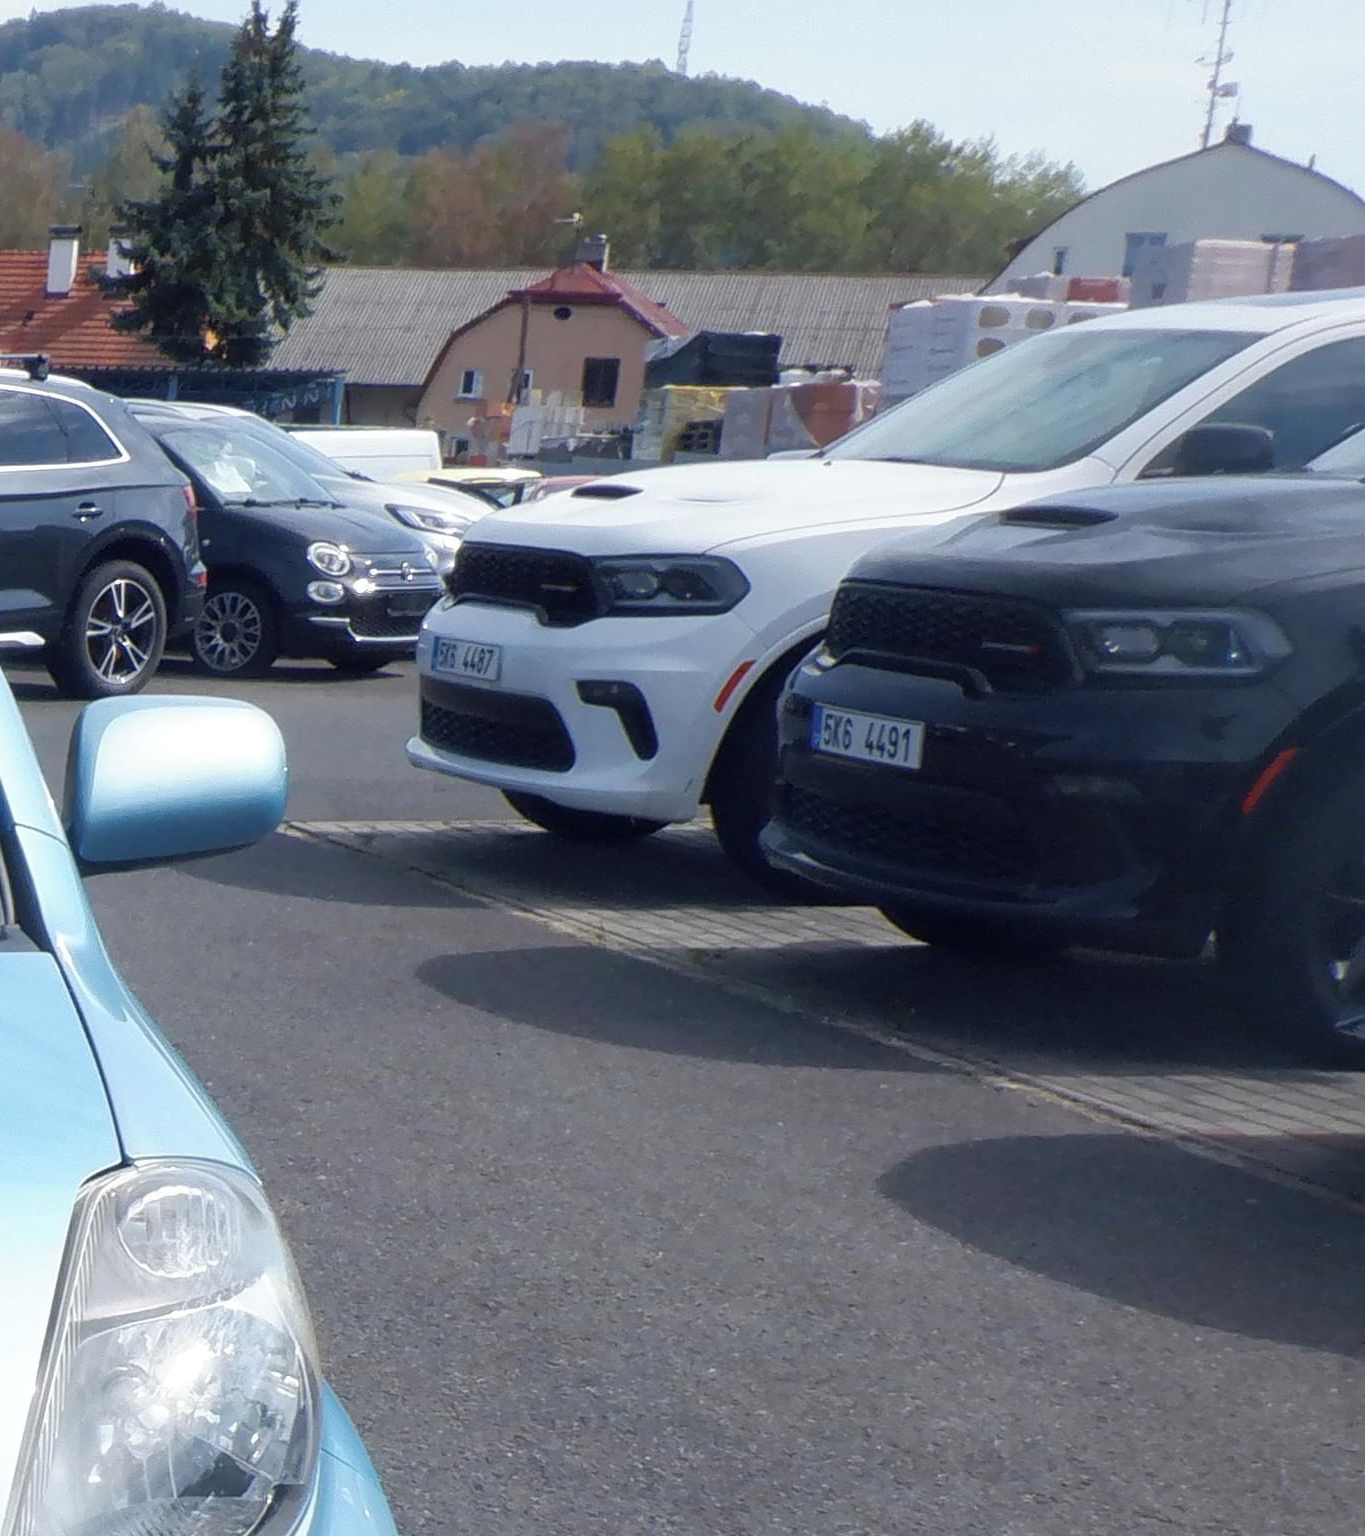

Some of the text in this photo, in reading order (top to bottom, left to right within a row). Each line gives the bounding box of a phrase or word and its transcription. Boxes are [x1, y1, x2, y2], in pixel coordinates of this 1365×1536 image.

[463, 645, 494, 676] 4487
[823, 713, 911, 763] 5K6 4491
